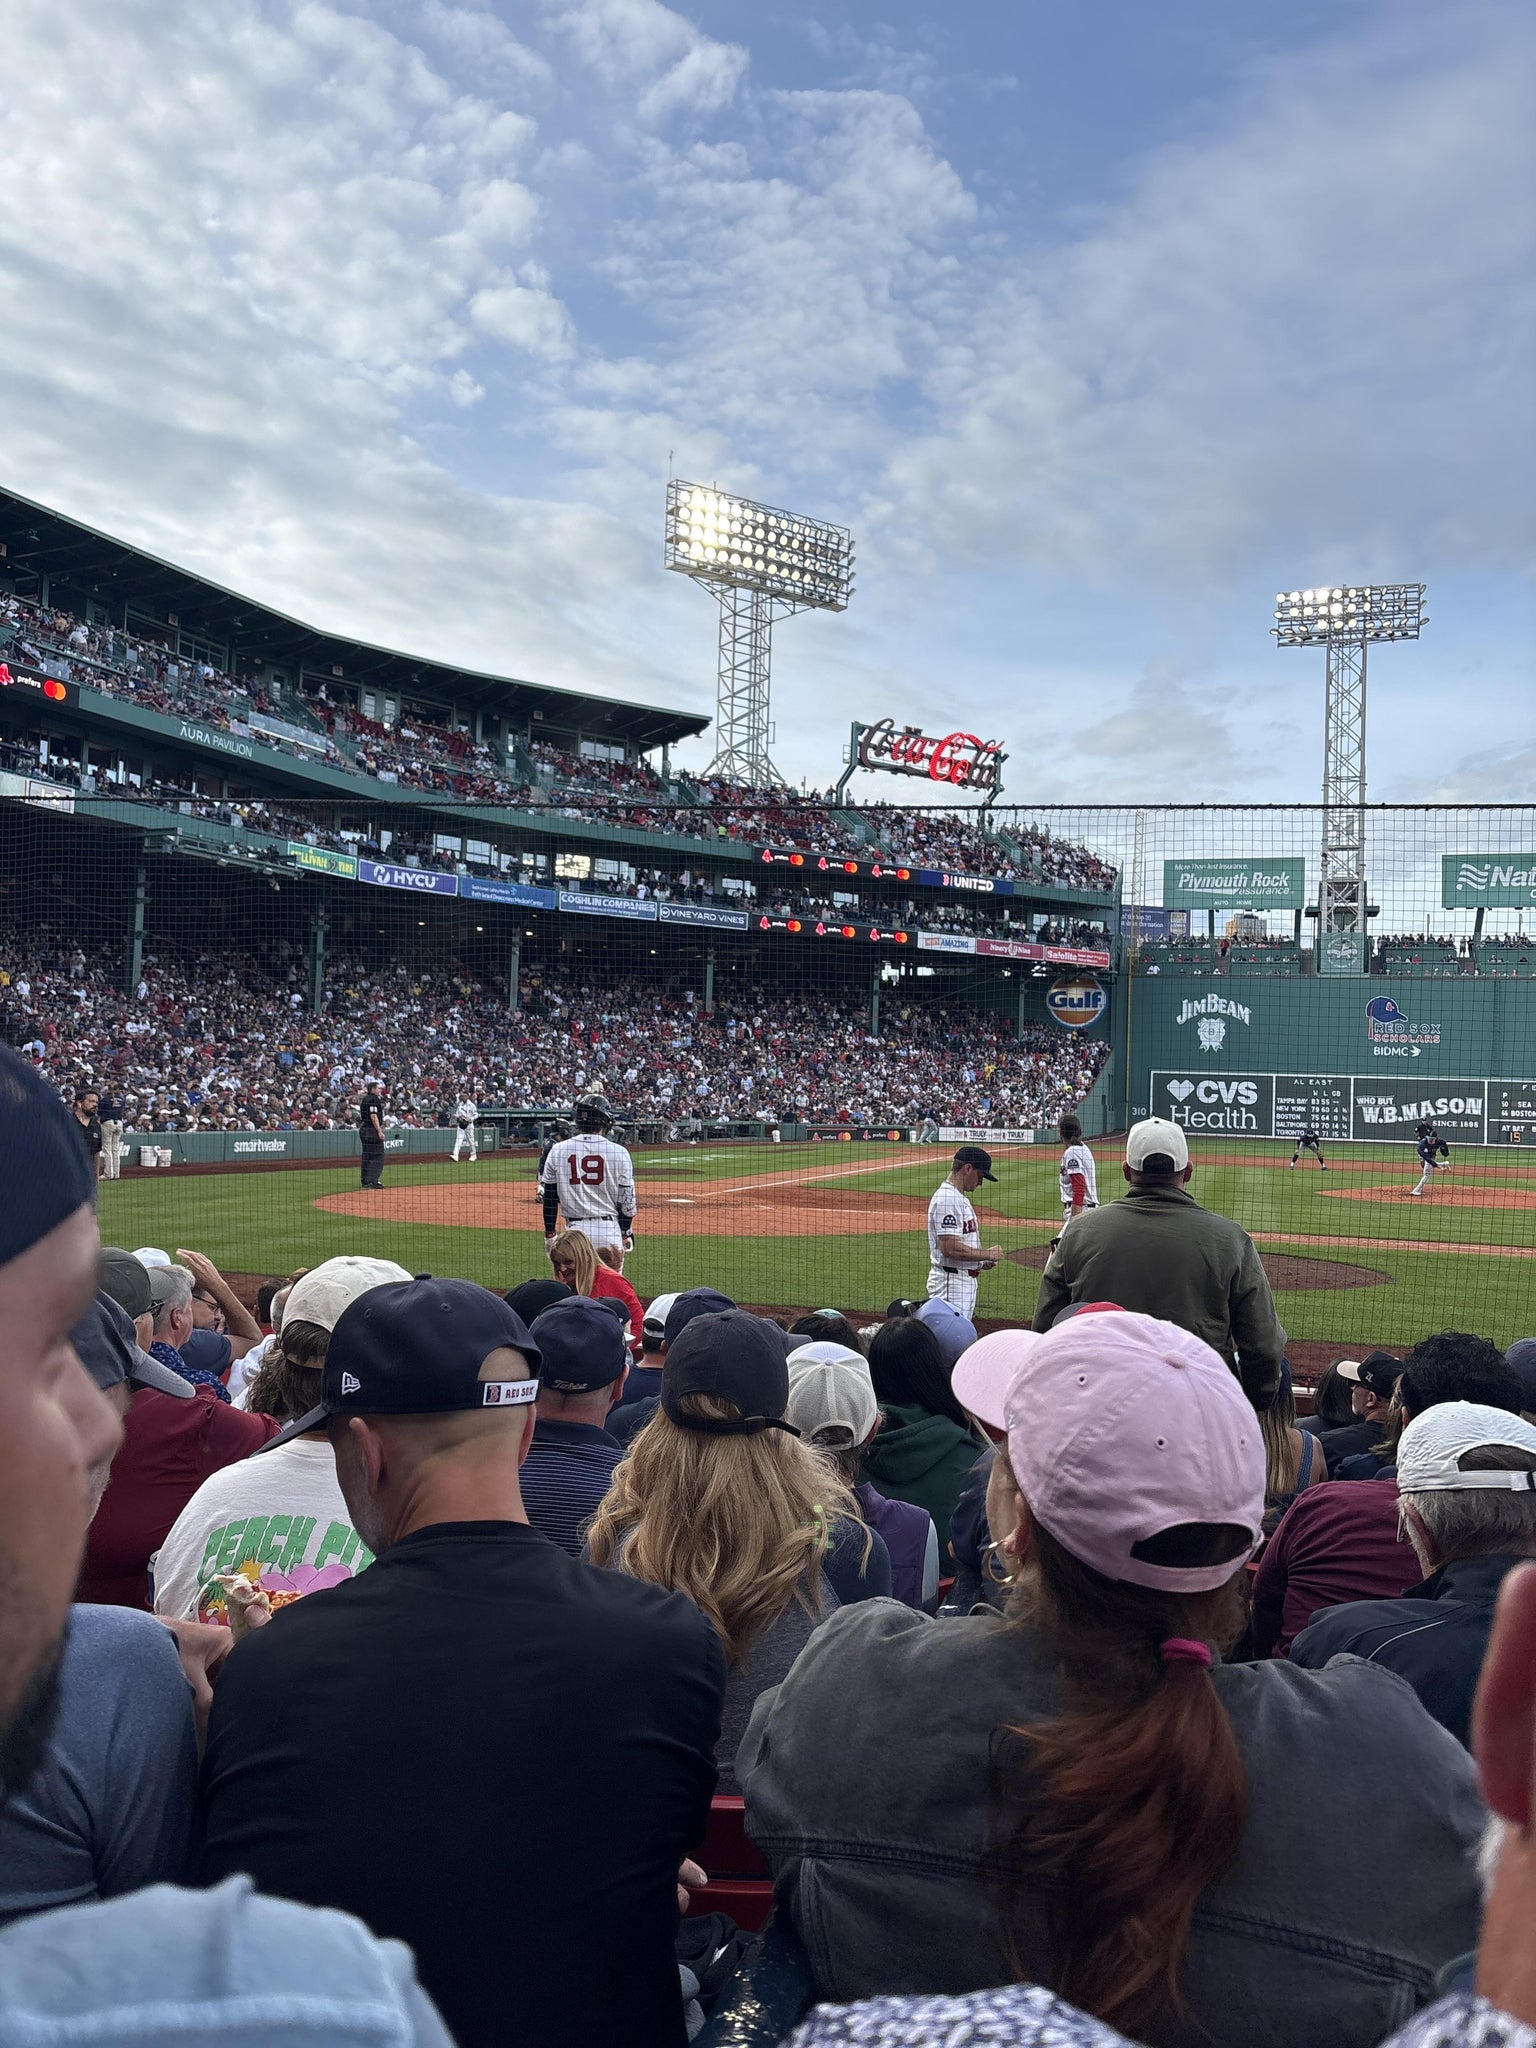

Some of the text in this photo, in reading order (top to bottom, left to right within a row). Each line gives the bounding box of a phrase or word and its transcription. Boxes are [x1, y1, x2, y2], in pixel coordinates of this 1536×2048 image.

[17, 675, 42, 689] prefers
[212, 735, 253, 758] PAVILION
[860, 718, 1005, 789] Coca-Cola
[393, 870, 436, 889] HYCU
[953, 876, 995, 892] UNITED
[1178, 871, 1290, 889] Plymouth Rock
[1238, 887, 1290, 896] assurance
[561, 894, 601, 907] COGHLIN
[602, 898, 655, 912] COMPANIES
[670, 908, 745, 925] VINEYARD VINES
[1048, 991, 1103, 1009] Gulf
[1374, 1022, 1441, 1035] RED SOX
[1373, 1034, 1441, 1044] SCHOLARS
[1373, 1045, 1409, 1057] BIDMC
[1196, 1080, 1259, 1105] CVS
[1356, 1097, 1395, 1105] WHO BUT
[1131, 1107, 1147, 1116] 310
[1169, 1105, 1258, 1130] Health
[1276, 1113, 1301, 1121] BOSTON
[1275, 1121, 1309, 1129] BALTIMORE
[1432, 1120, 1479, 1129] SINCE 1898
[233, 1139, 287, 1153] smartwater
[567, 1154, 605, 1186] 19
[505, 1388, 520, 1399] RED
[520, 1386, 535, 1397] SOX
[198, 1514, 318, 1586] PEACH
